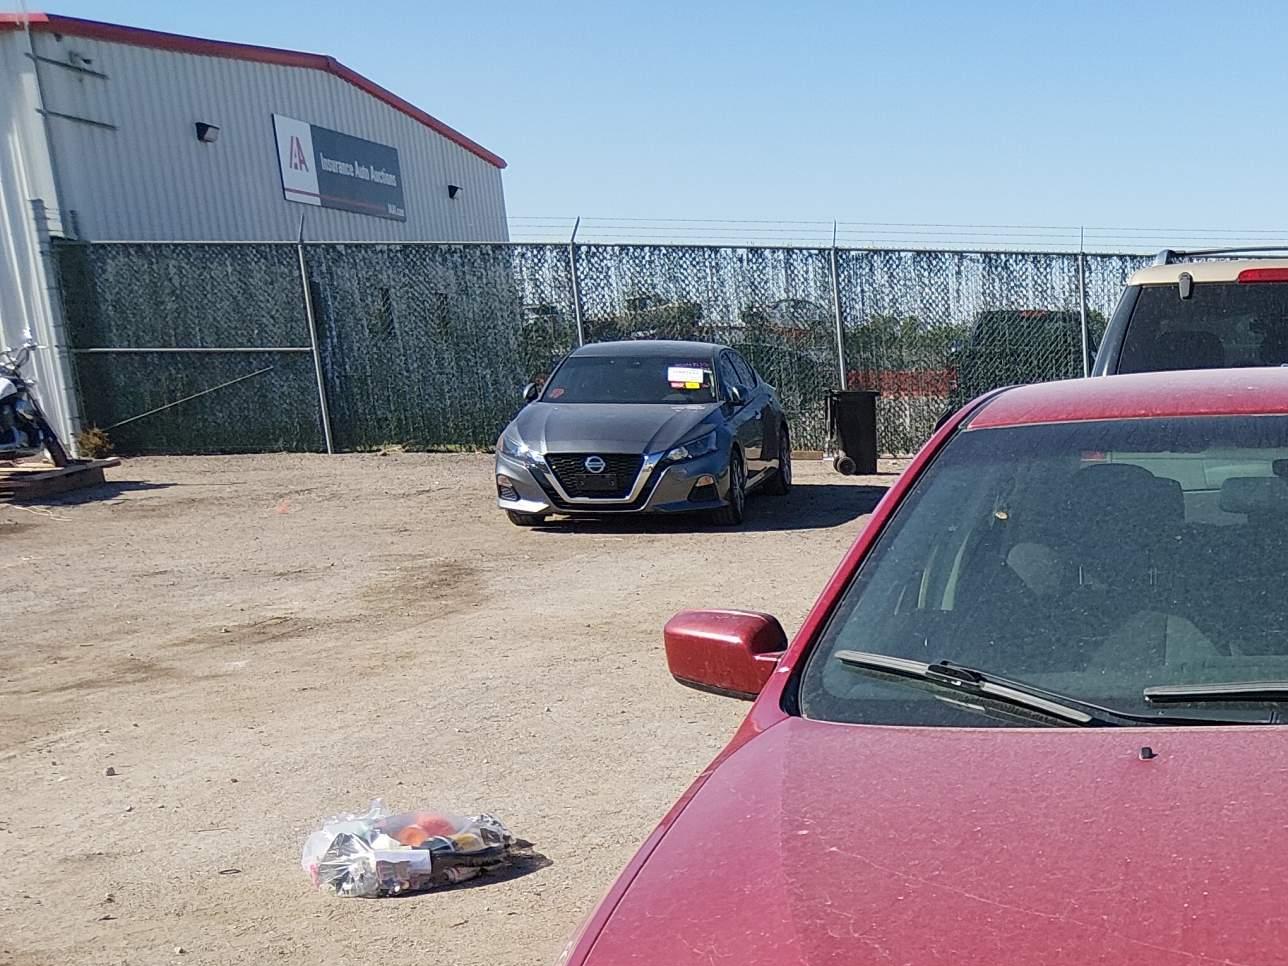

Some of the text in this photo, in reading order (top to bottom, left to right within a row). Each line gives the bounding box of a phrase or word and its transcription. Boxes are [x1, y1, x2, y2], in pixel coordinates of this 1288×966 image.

[319, 152, 397, 187] Insurance Auto Auctions
